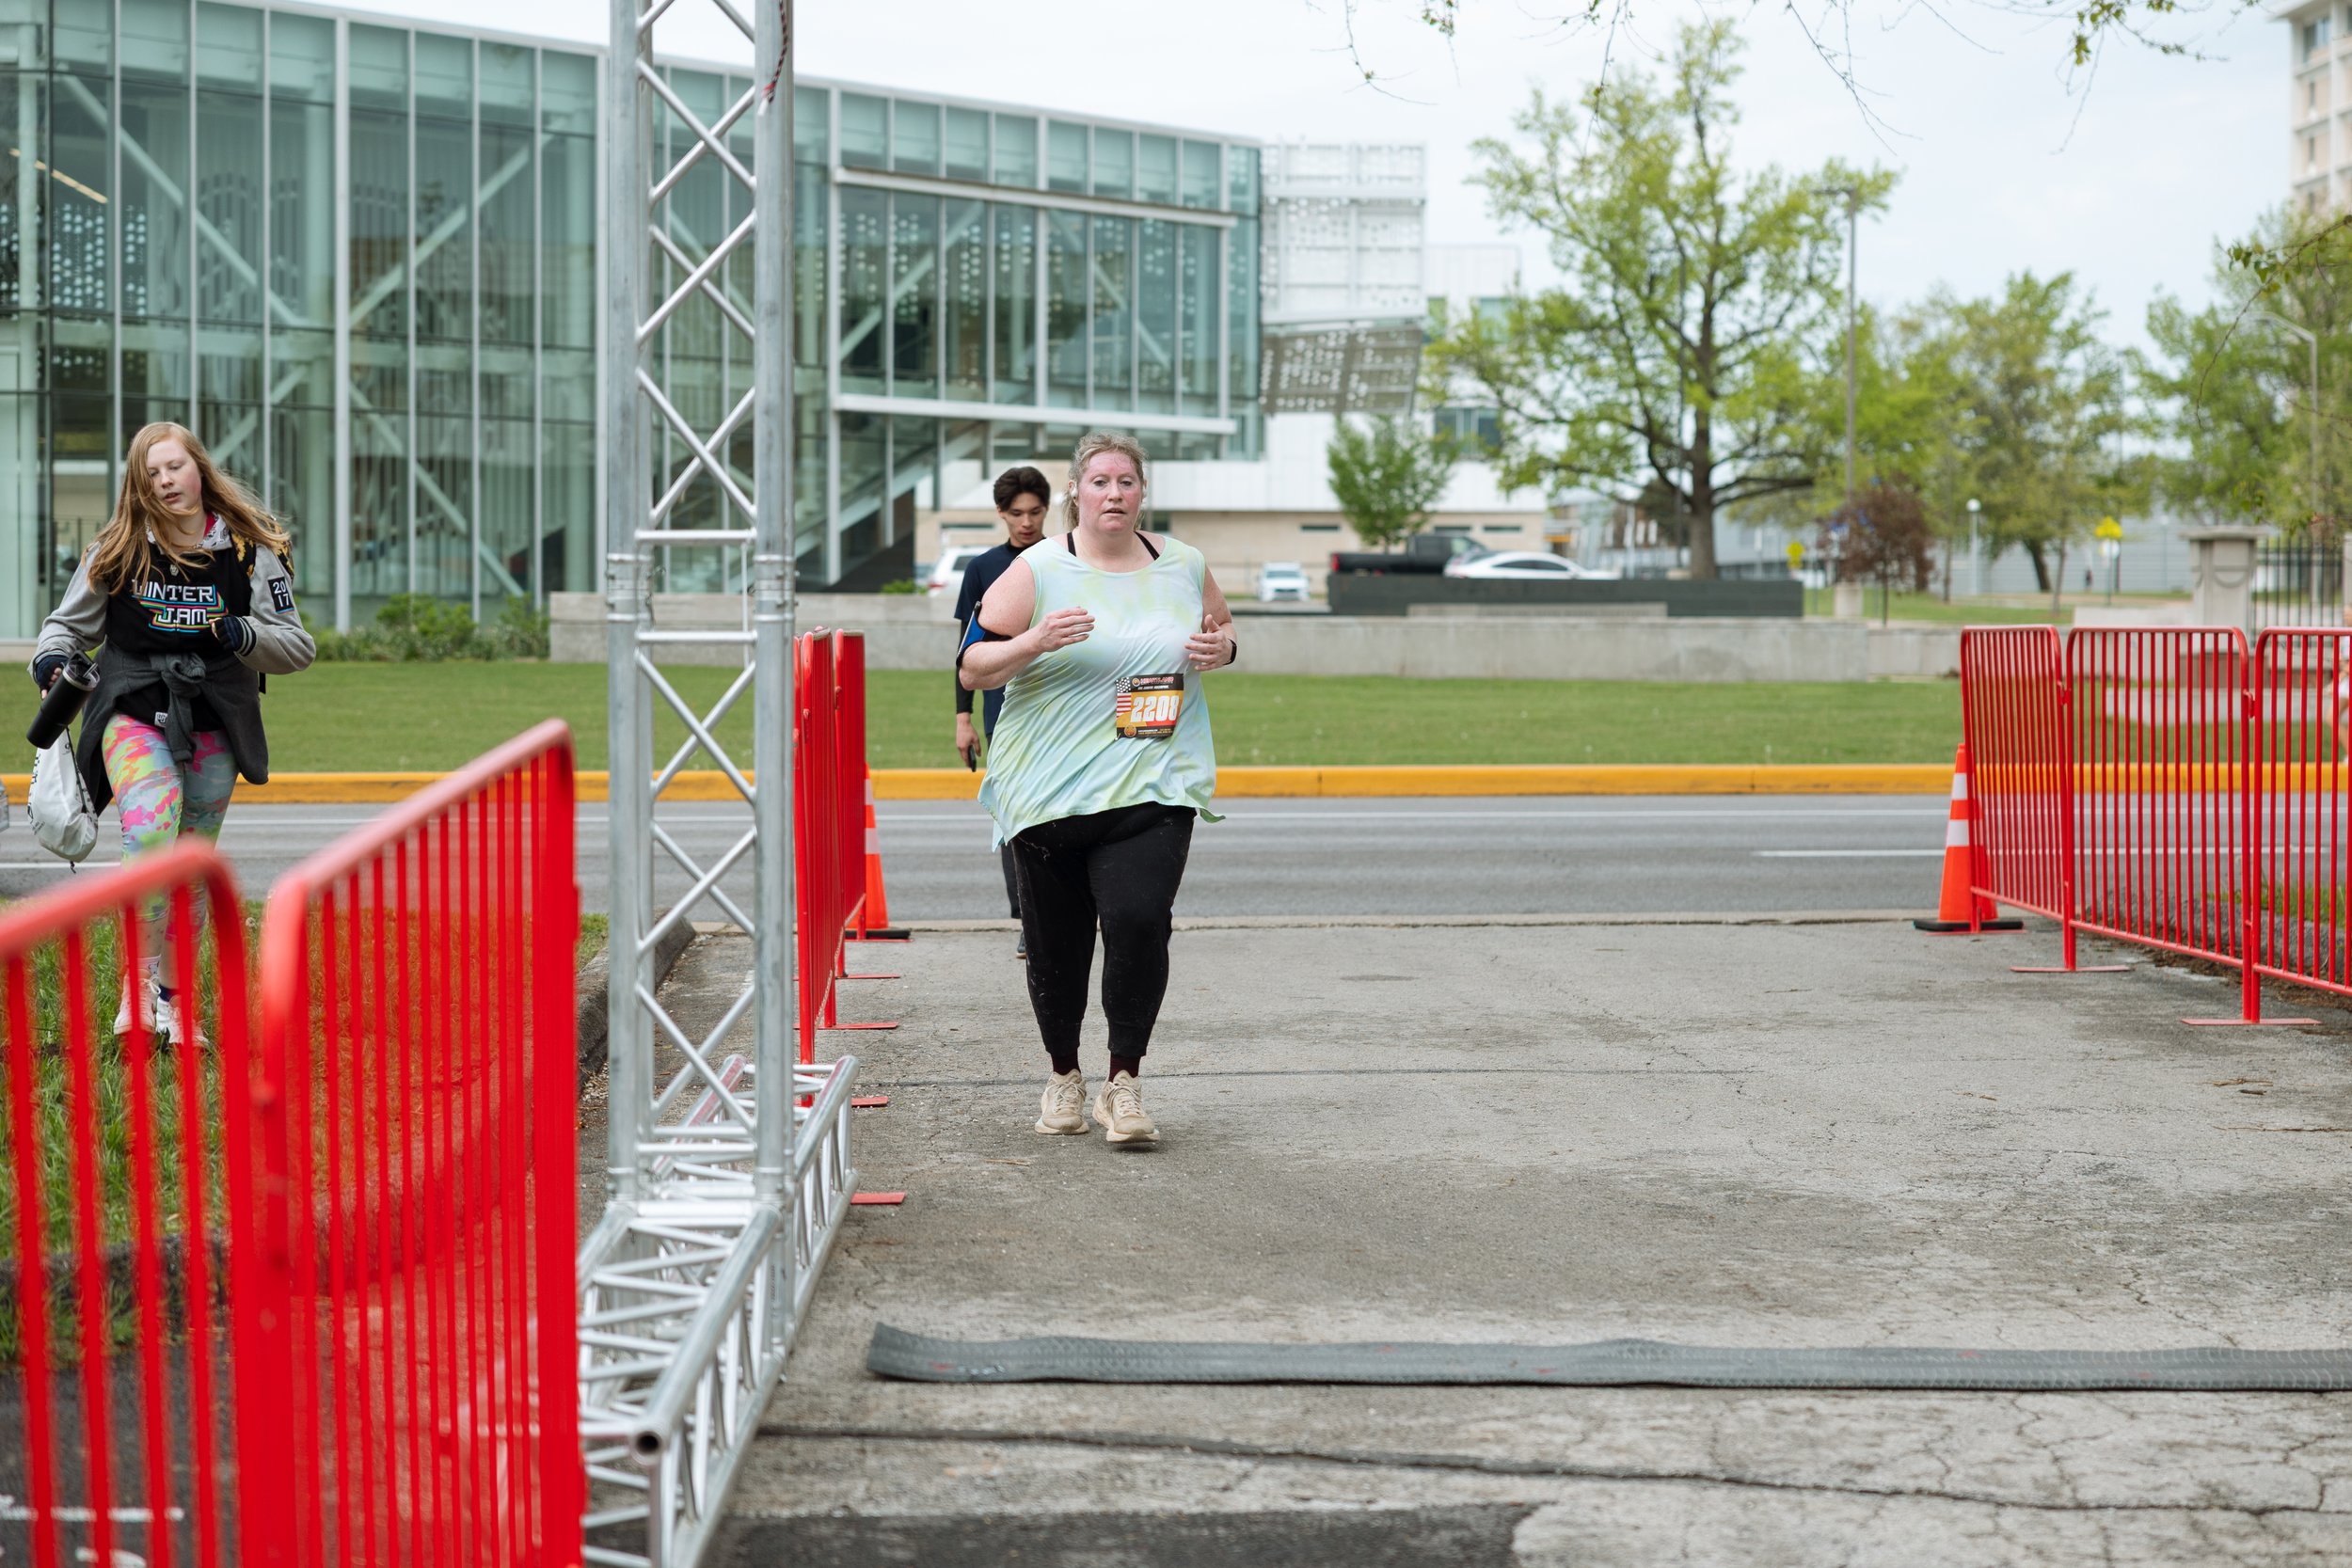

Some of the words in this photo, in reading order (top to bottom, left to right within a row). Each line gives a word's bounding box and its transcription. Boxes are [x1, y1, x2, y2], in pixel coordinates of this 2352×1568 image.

[273, 580, 286, 594] 20
[278, 594, 289, 608] 17
[158, 608, 209, 625] JAM
[1130, 695, 1179, 722] 2208
